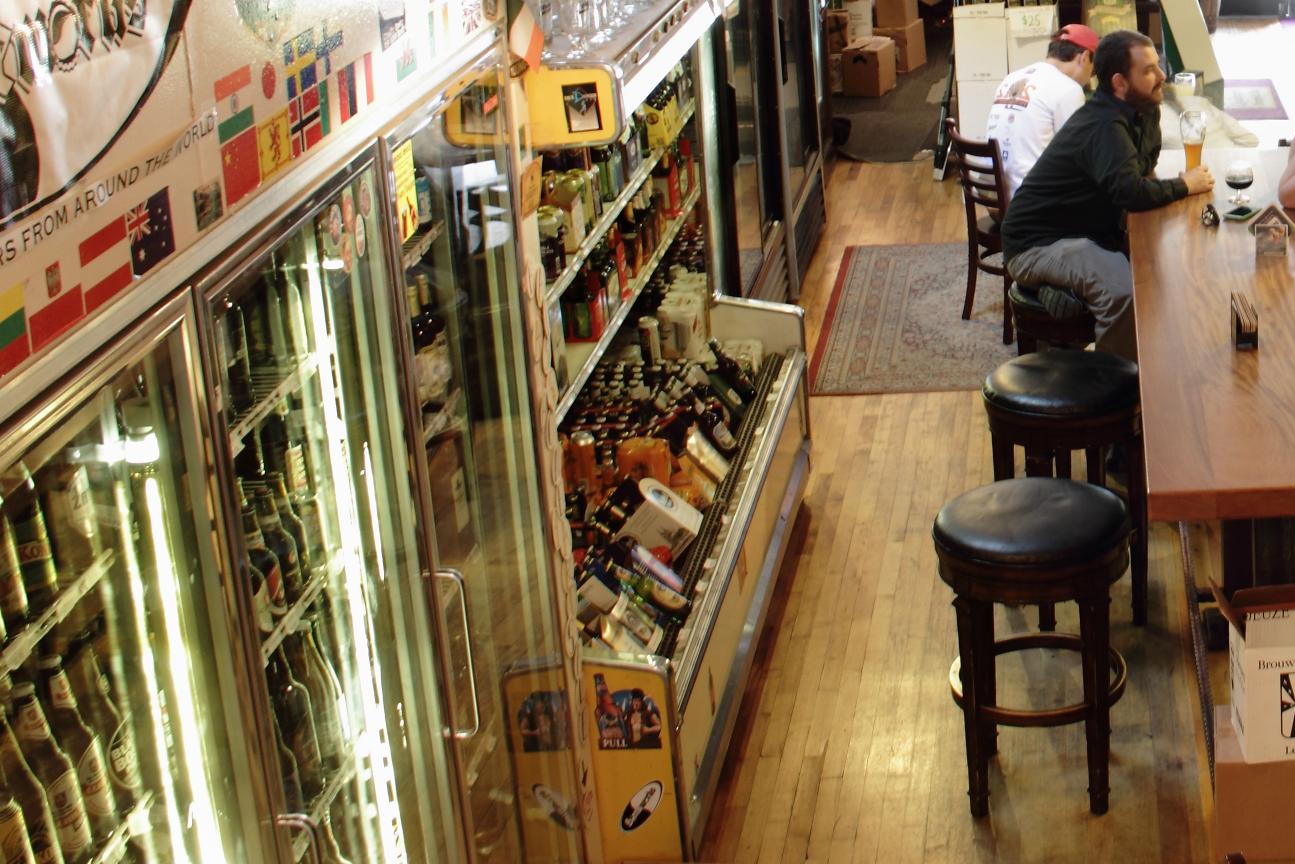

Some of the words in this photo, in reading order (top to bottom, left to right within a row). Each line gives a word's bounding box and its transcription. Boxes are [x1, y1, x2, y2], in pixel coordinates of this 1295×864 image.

[1021, 14, 1042, 27] $25
[21, 206, 68, 252] FROM
[74, 165, 141, 214] AROUND
[145, 147, 171, 176] THE
[174, 114, 217, 160] WORLD
[602, 738, 628, 748] PULL
